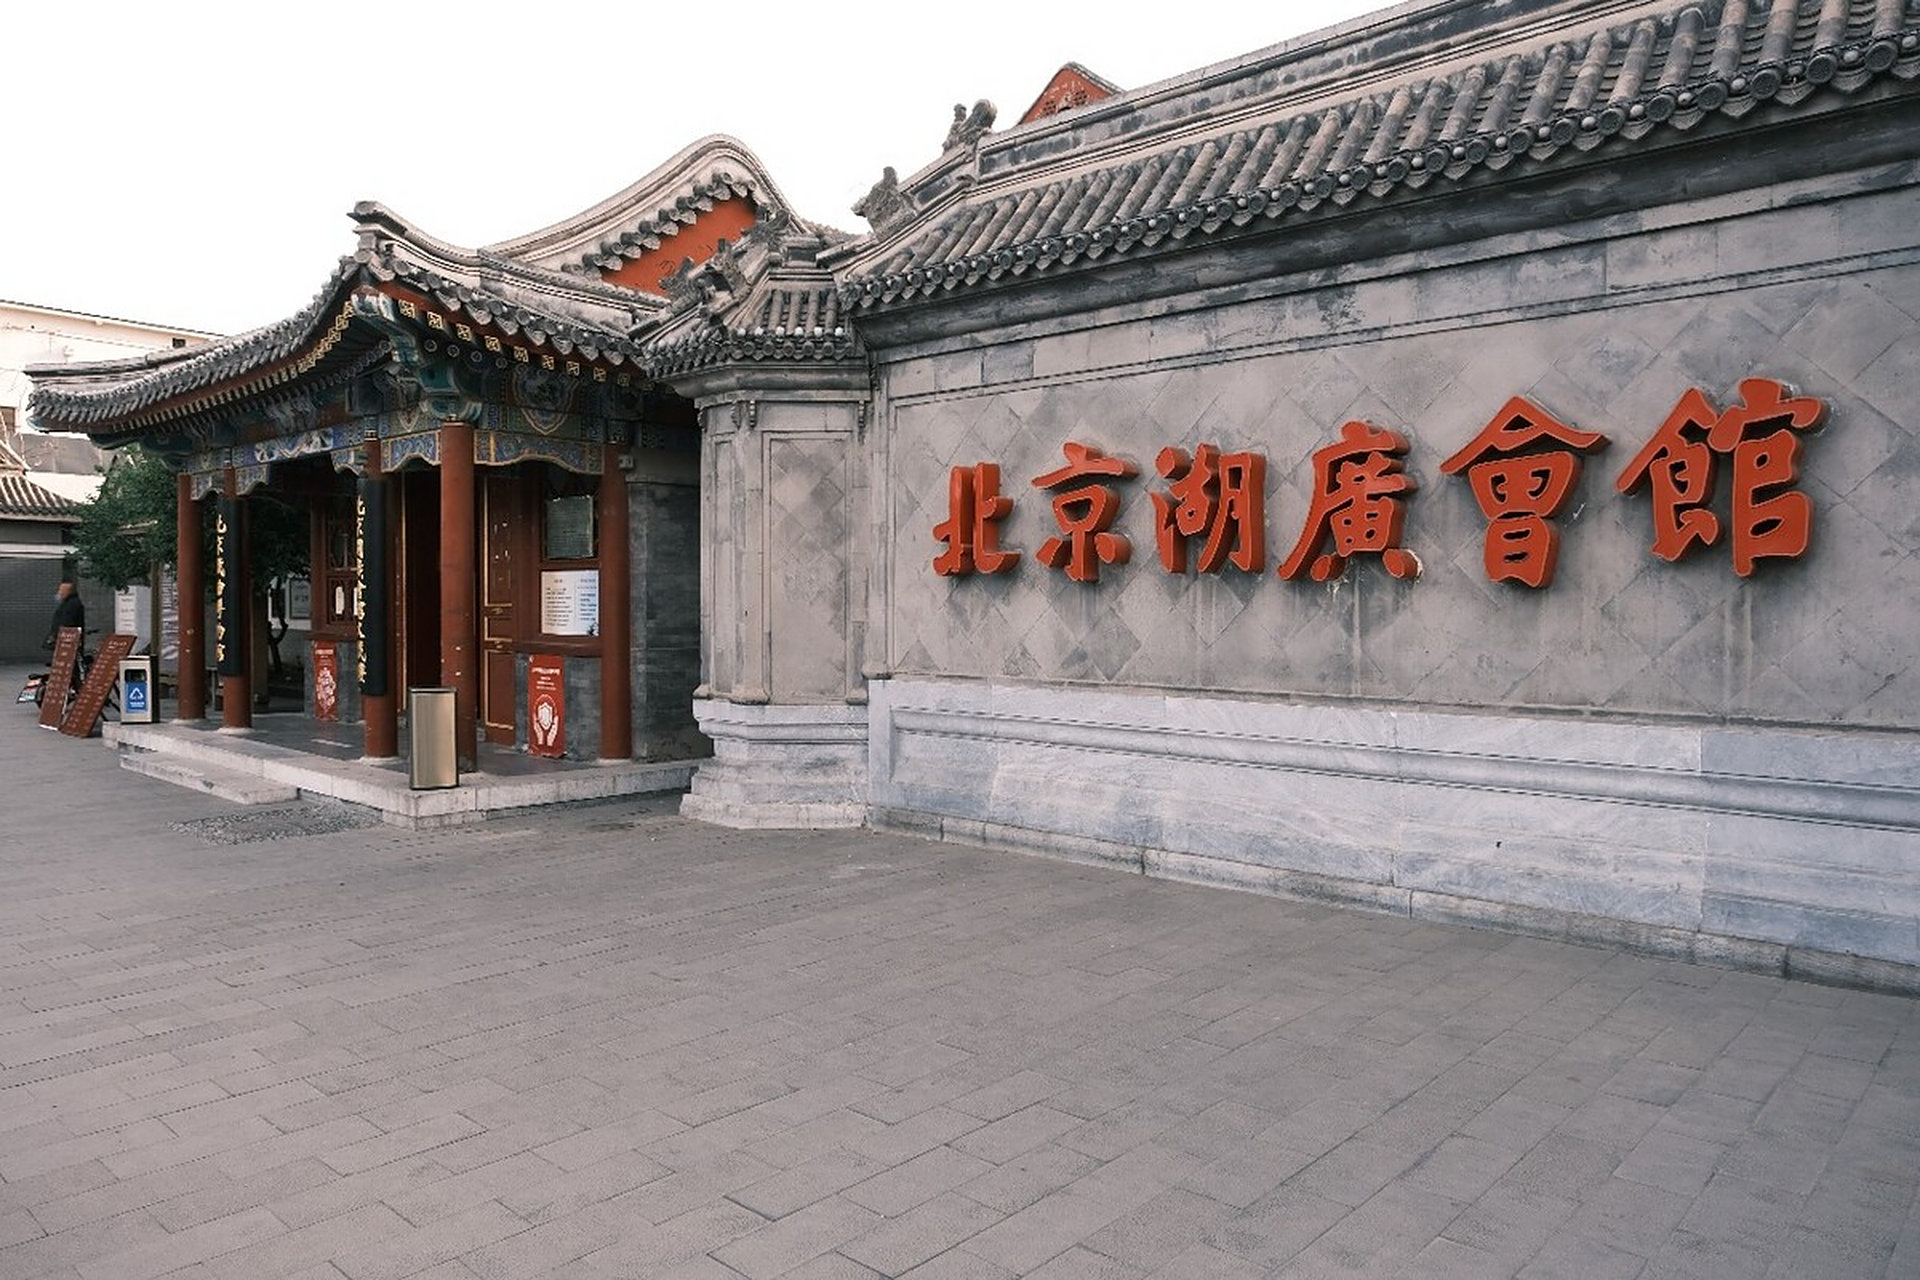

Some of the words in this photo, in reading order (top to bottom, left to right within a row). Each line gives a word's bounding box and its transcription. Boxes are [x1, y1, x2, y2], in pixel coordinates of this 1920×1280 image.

[932, 377, 1829, 589] 北京湖廣會館
